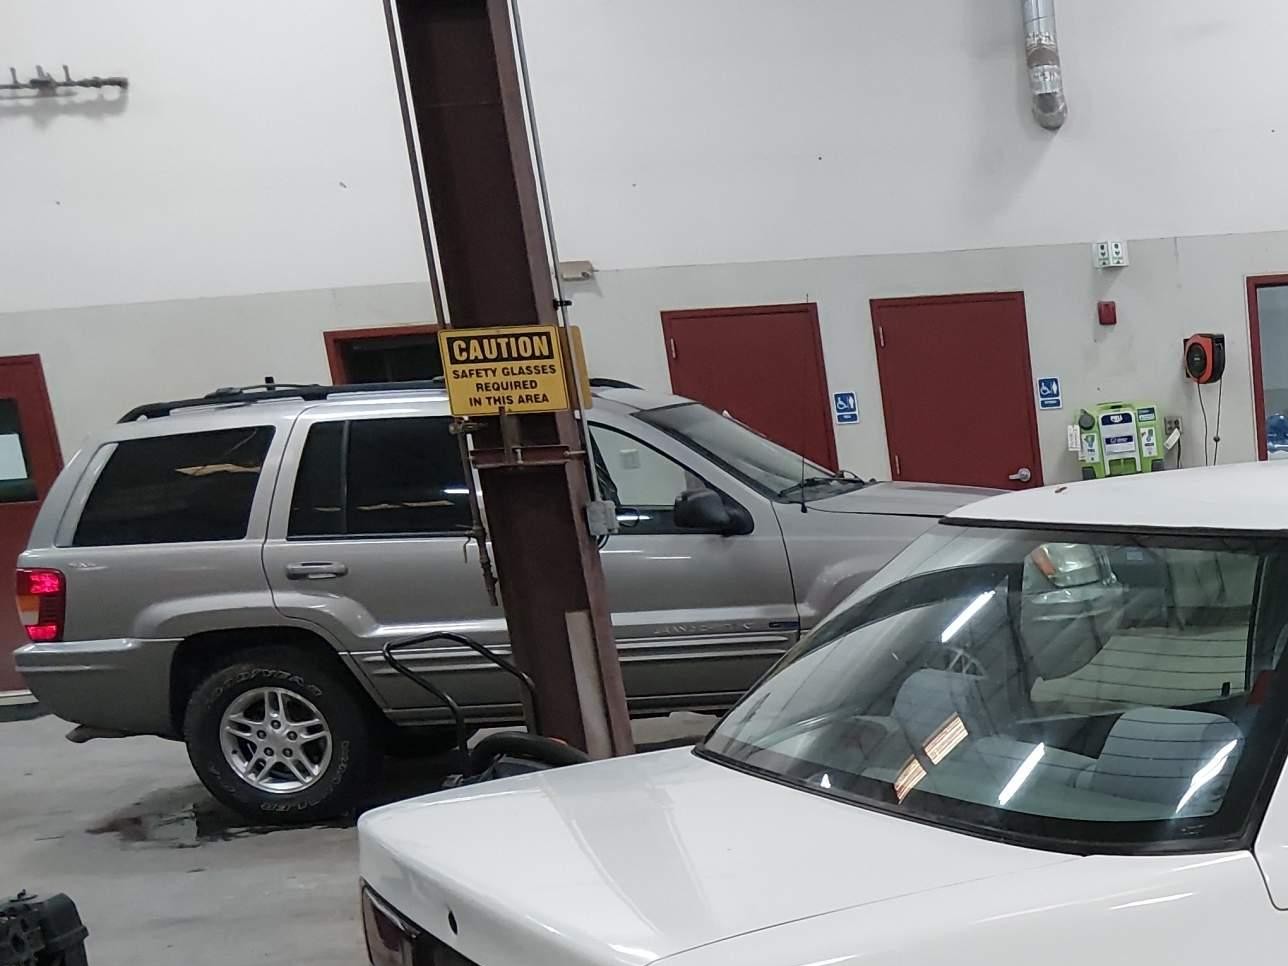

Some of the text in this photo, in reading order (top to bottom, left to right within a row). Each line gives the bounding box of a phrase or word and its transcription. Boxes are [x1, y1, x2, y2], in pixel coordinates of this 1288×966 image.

[452, 335, 549, 361] CAUTION
[452, 364, 557, 379] SAFETY GLASSES
[475, 379, 538, 392] REQUIRED
[469, 393, 549, 407] IN THIS AREA
